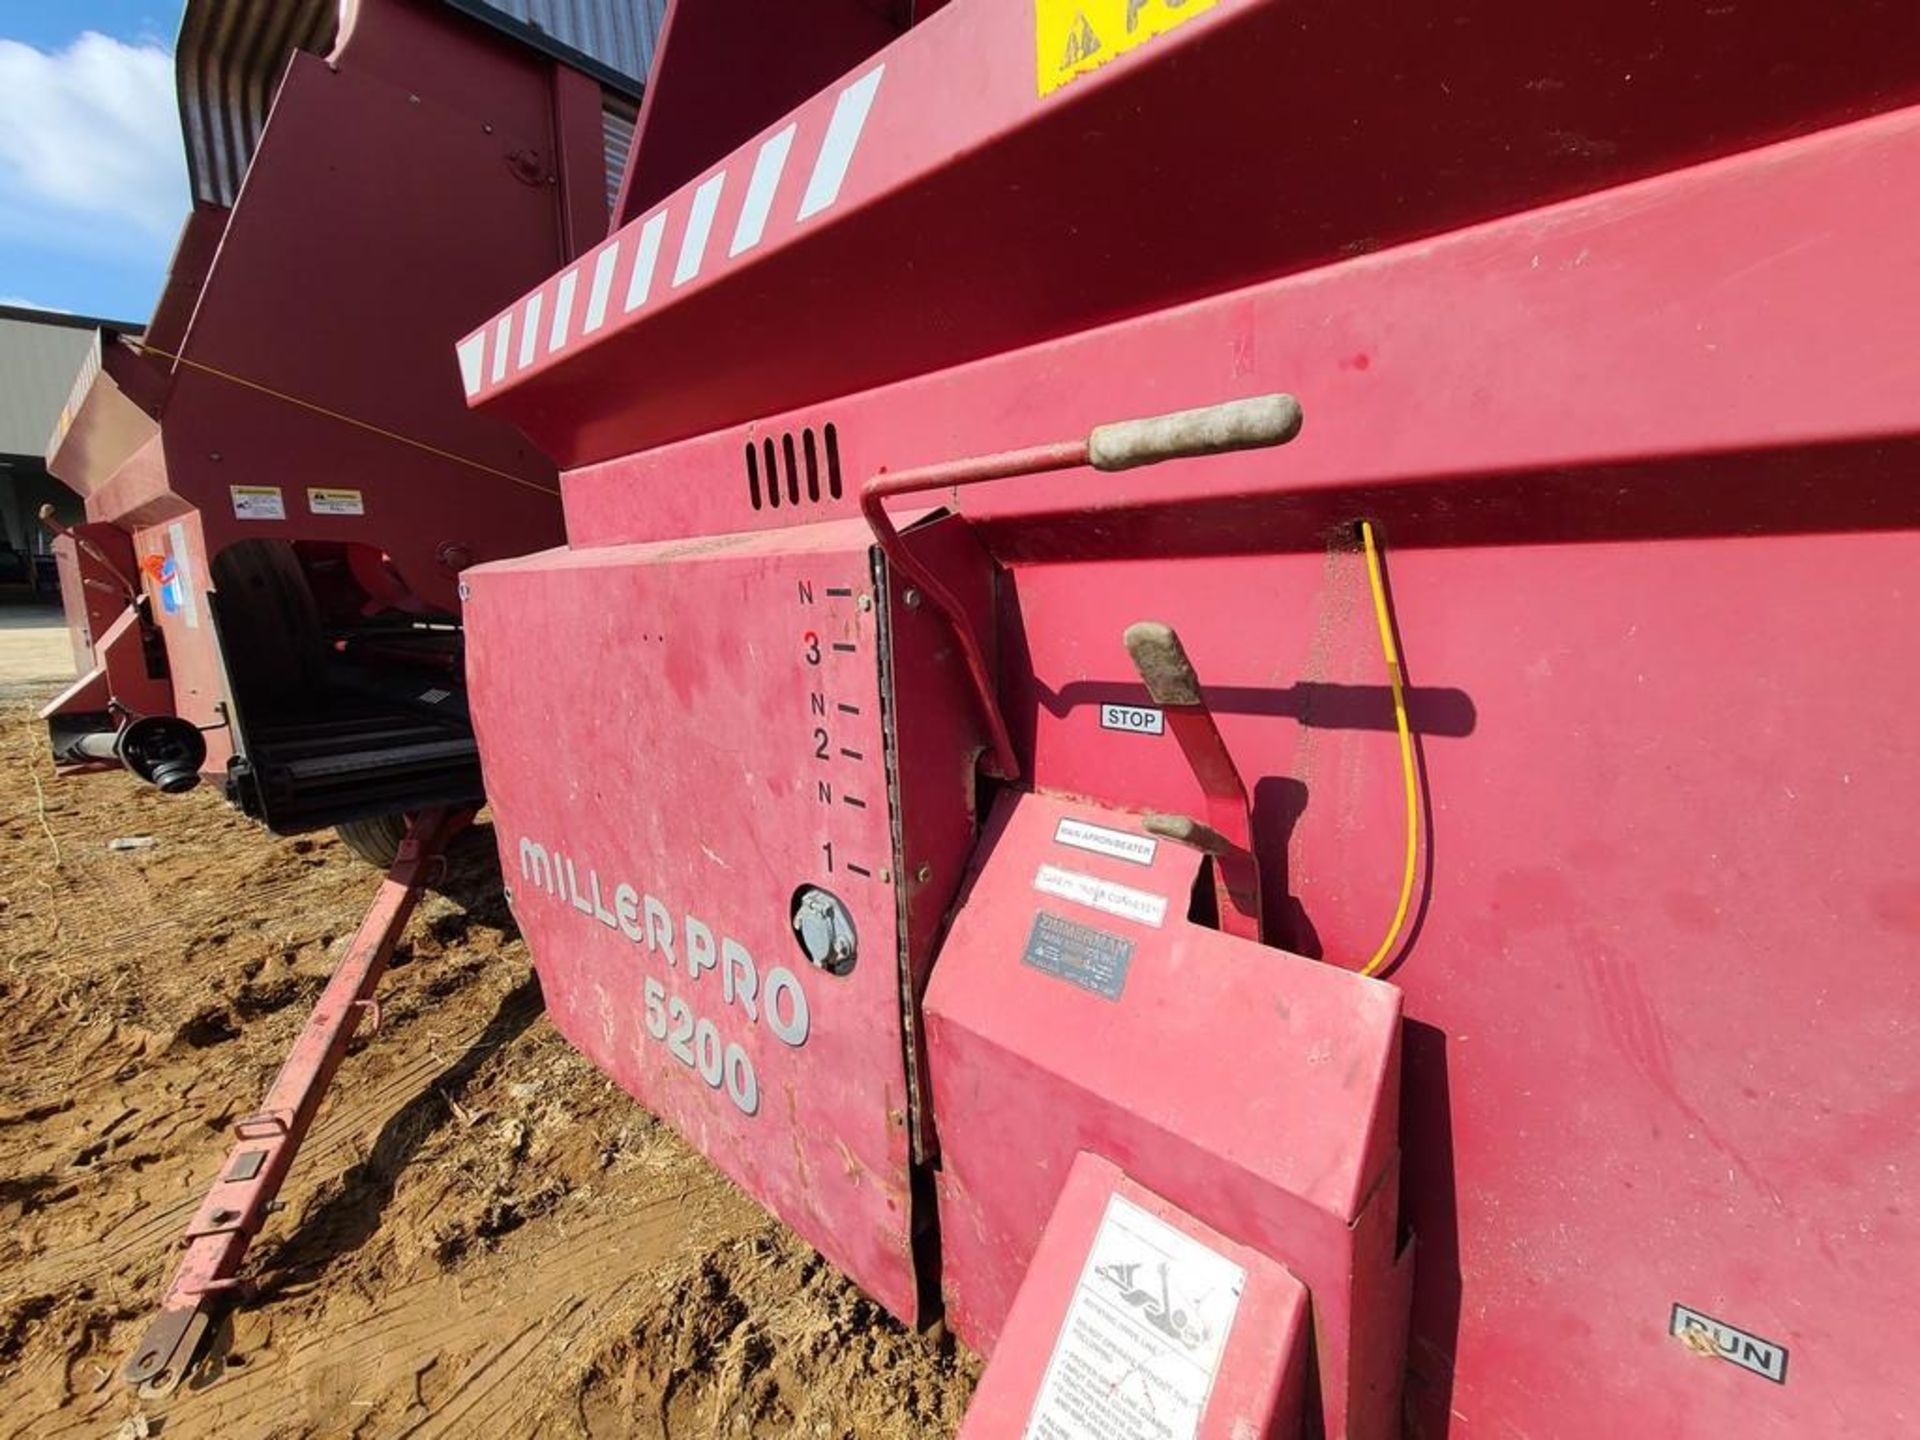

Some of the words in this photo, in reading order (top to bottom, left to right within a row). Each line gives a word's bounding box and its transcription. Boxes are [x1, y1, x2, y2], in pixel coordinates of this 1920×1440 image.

[798, 581, 813, 603] N
[804, 632, 821, 665] 3
[811, 693, 825, 716] N
[1108, 708, 1156, 728] STOP
[814, 728, 829, 760] 2
[819, 781, 831, 804] N
[823, 842, 833, 873] 1
[520, 836, 677, 966] MILLER
[685, 914, 810, 1046] PRO
[644, 976, 758, 1116] 5200
